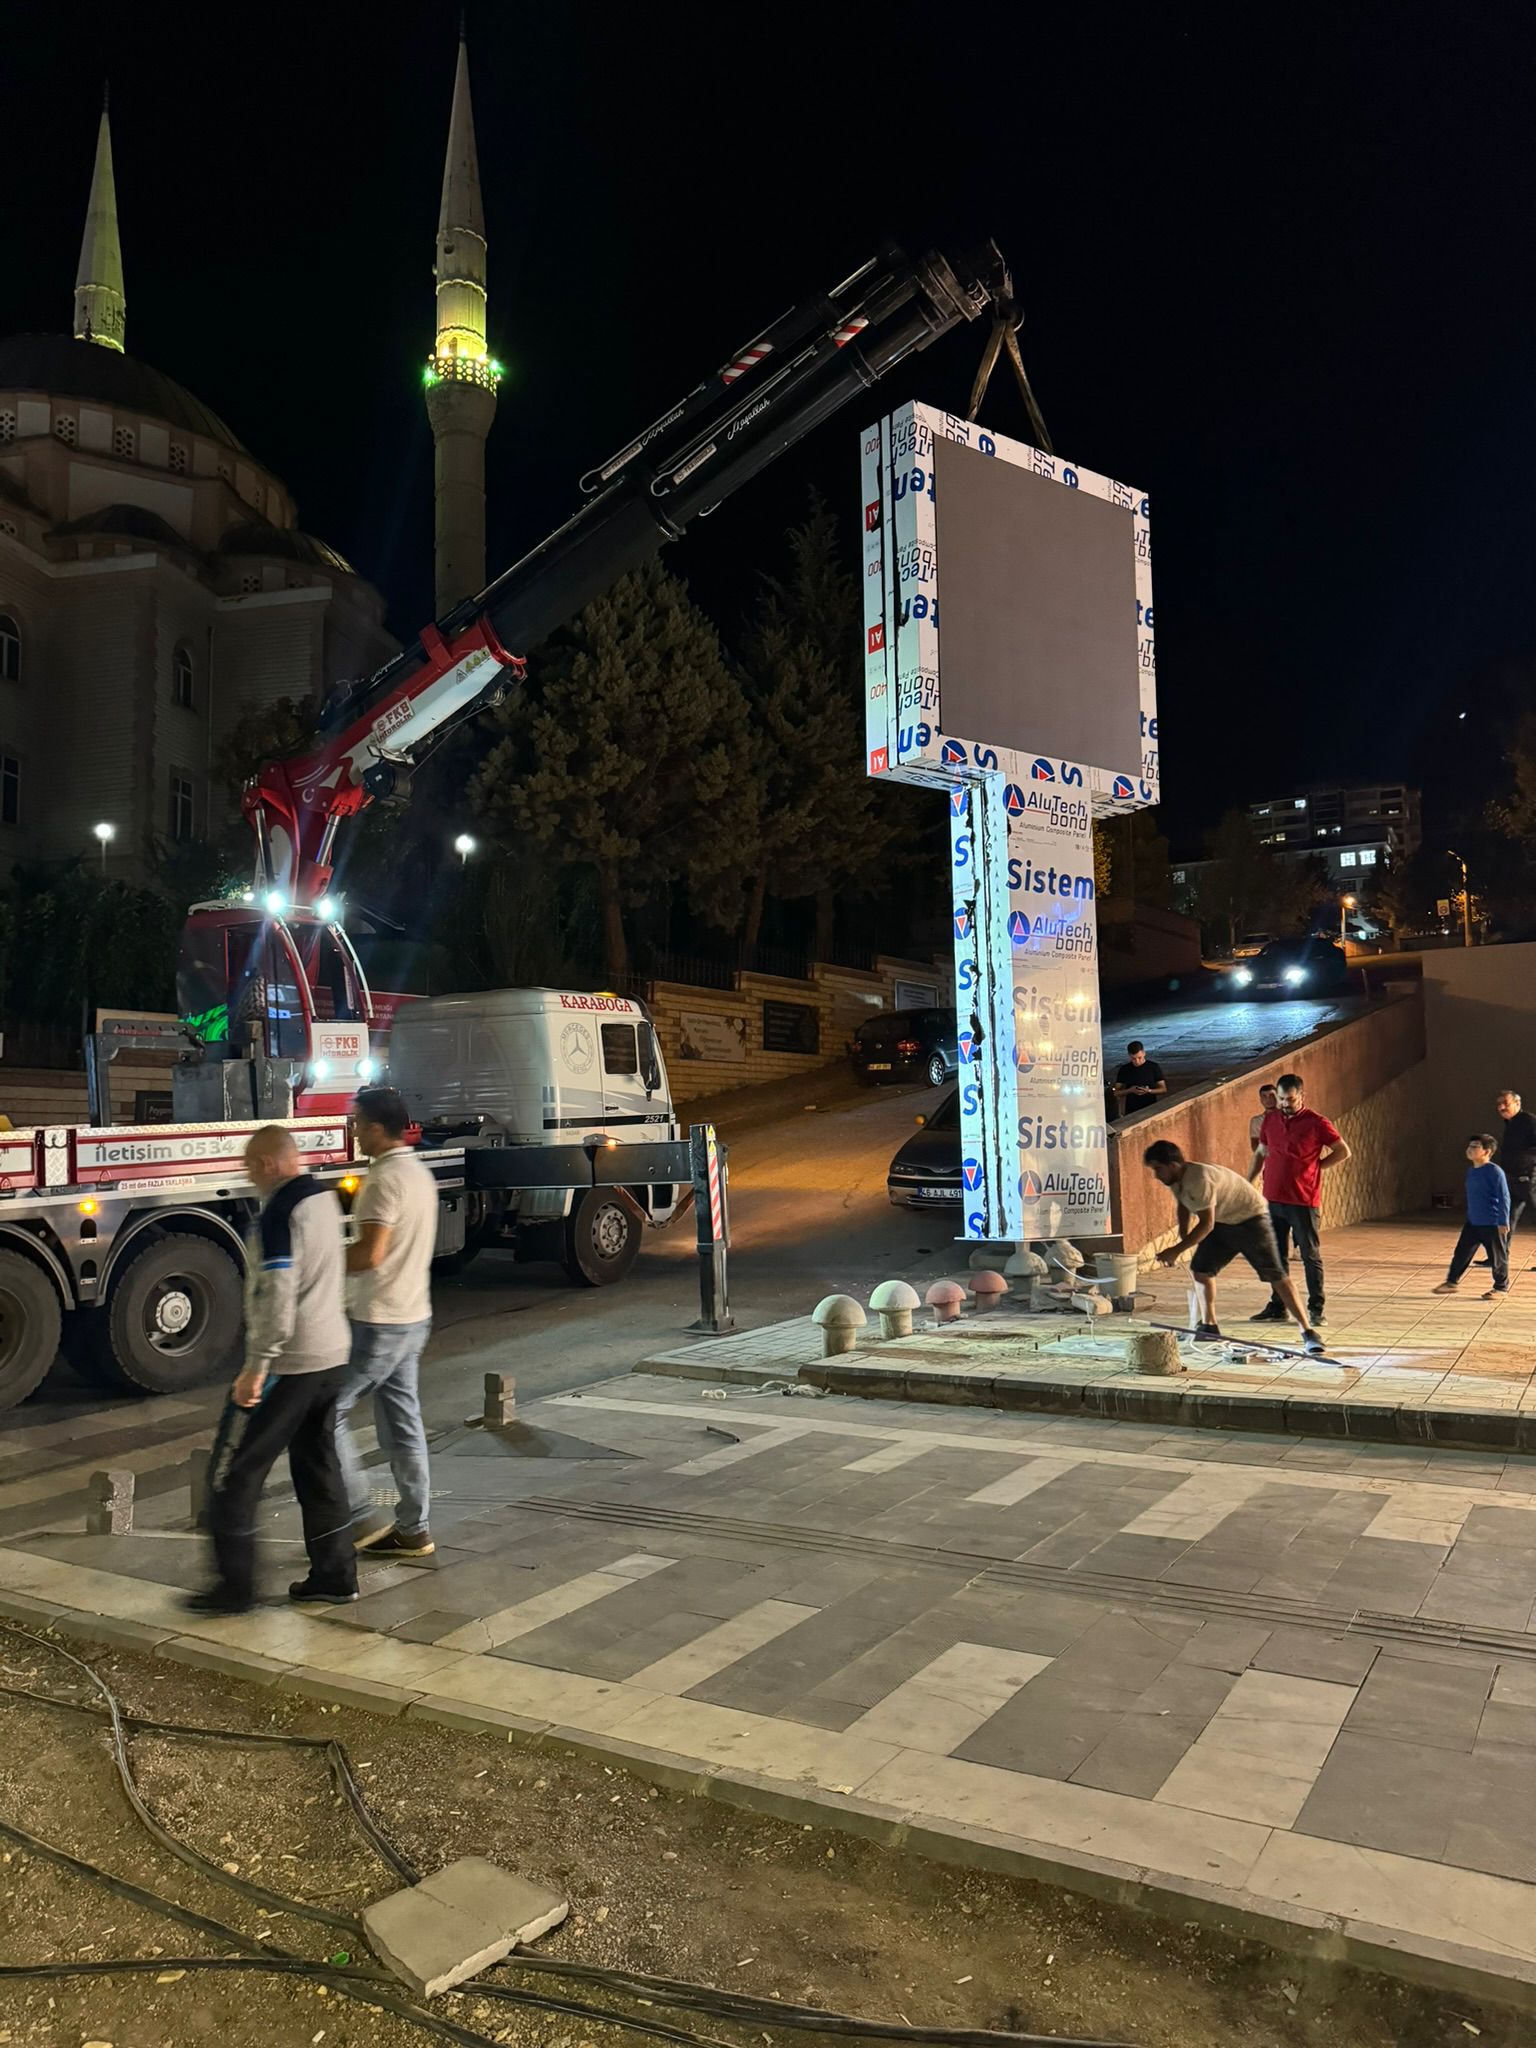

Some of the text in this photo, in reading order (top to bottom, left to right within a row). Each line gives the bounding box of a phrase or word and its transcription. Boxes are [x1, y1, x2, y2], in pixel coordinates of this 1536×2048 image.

[385, 701, 410, 725] FKB
[1027, 791, 1086, 817] AluTech
[1020, 821, 1087, 839] Aluminium Composite Panel
[1050, 808, 1088, 831] bond
[1005, 858, 1094, 900] Sistem
[1032, 916, 1091, 940] AluTech
[1056, 931, 1093, 954] bond
[1051, 950, 1078, 960] Composite
[560, 994, 633, 1013] KARABOGA
[1011, 986, 1100, 1024] Sistem
[335, 1036, 358, 1049] FKB
[1061, 1058, 1099, 1078] bond
[644, 1114, 664, 1124] 2521
[1016, 1116, 1105, 1149] Sistem
[181, 1140, 236, 1157] 0534
[315, 1133, 335, 1147] 23
[1044, 1172, 1104, 1192] AluTech
[1068, 1186, 1105, 1206] bond
